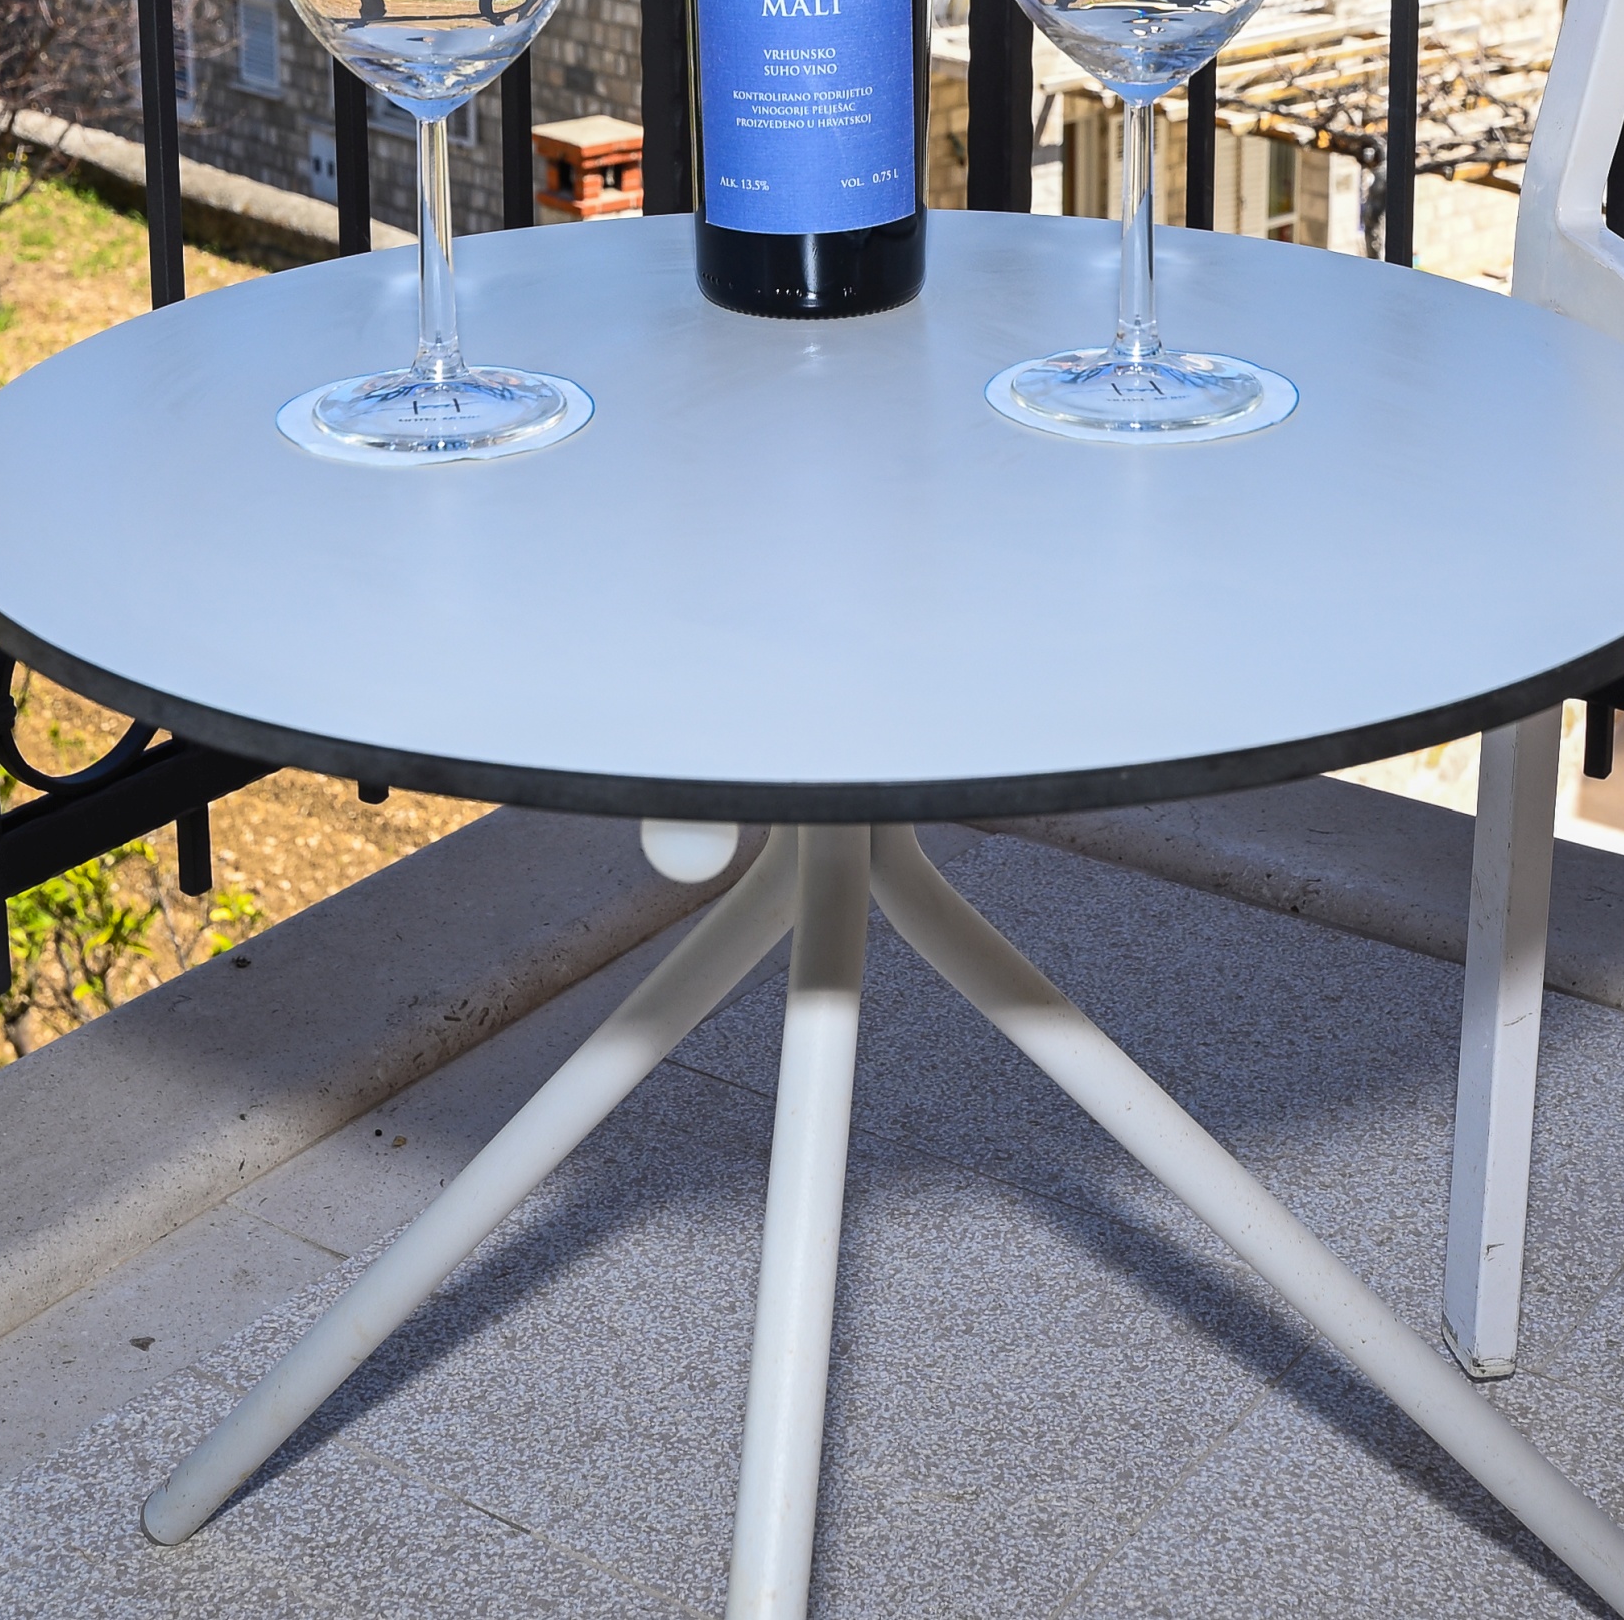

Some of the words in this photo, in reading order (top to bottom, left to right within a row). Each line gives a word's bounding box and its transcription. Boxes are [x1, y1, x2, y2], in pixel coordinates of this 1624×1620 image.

[763, 48, 836, 60] VRHUNSKO
[763, 64, 801, 76] SUHO
[803, 64, 837, 75] VINO
[733, 90, 811, 102] KONTROLIRANO
[813, 86, 873, 100] PODRIJETLO
[751, 104, 809, 116] VINOGORJE
[812, 102, 856, 114] PELJEŠAC
[736, 117, 805, 128] PROIZVEDENO
[807, 119, 815, 128] U
[817, 114, 872, 128] HRVATSKOJ
[893, 168, 899, 179] L
